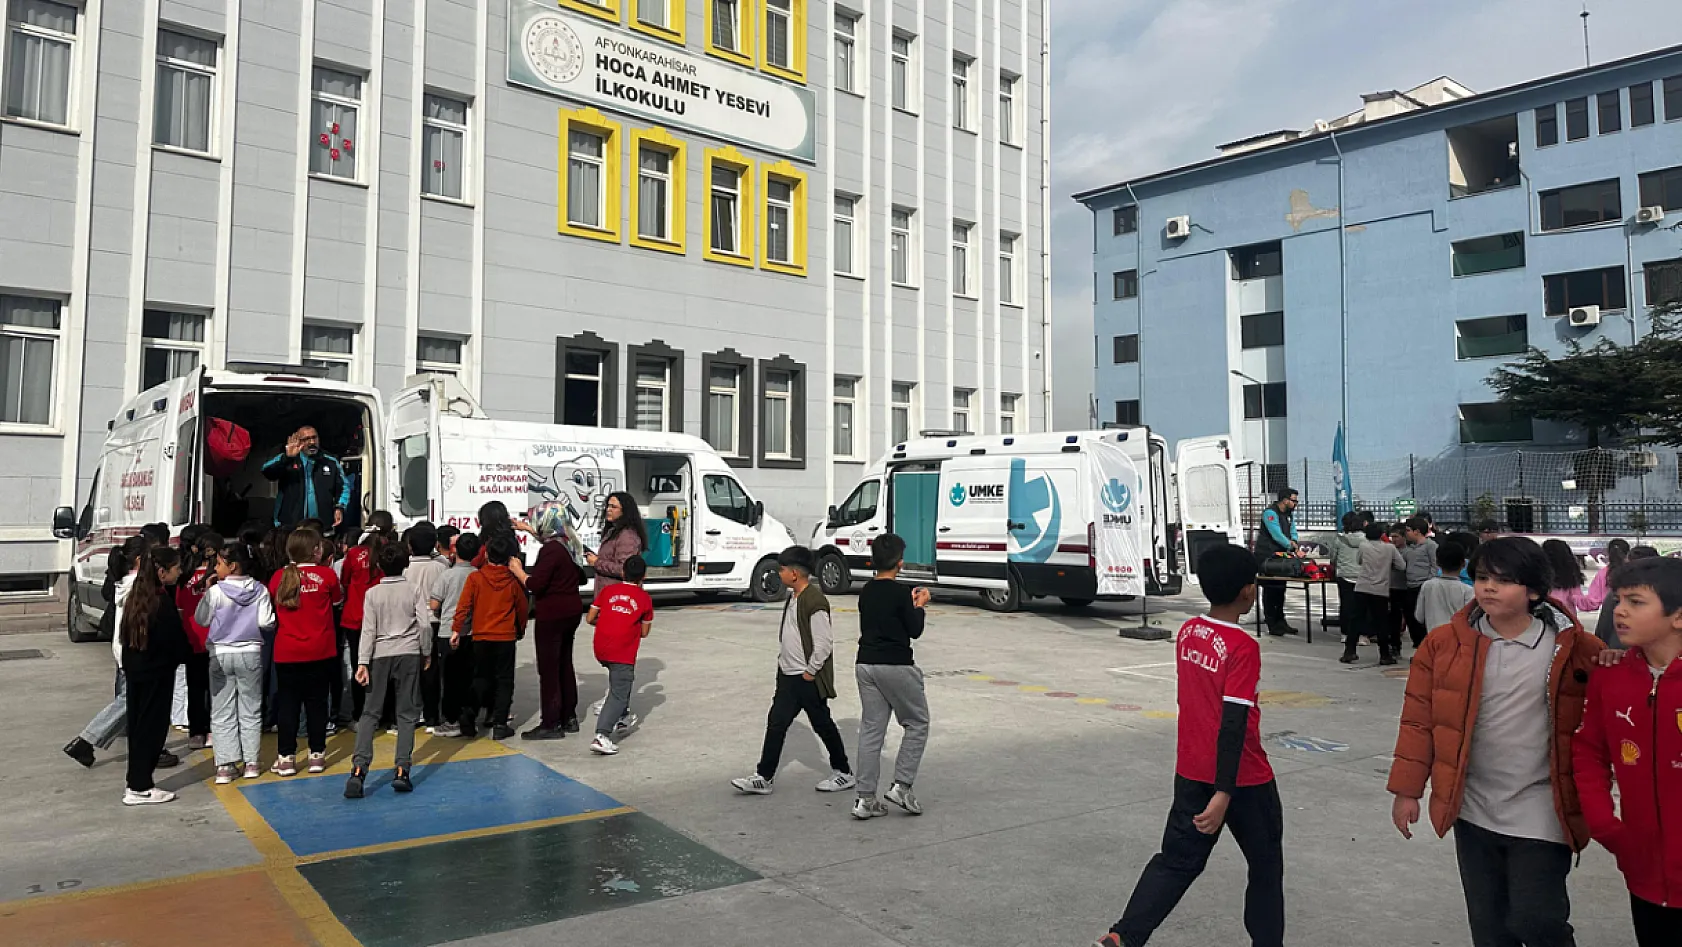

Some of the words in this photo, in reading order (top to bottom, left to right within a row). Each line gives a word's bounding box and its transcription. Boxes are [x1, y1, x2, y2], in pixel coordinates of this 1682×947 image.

[595, 36, 697, 76] AFYONKARAHİSAR
[596, 53, 647, 81] HOCA
[651, 69, 710, 100] AHMET
[715, 88, 771, 118] YESEVİ
[596, 73, 686, 116] İLKOKULU
[496, 463, 523, 473] Sağlık
[469, 484, 477, 494] İL
[480, 484, 513, 494] SAĞLIK
[969, 485, 1005, 498] UMKE
[448, 517, 472, 530] ĞIZ
